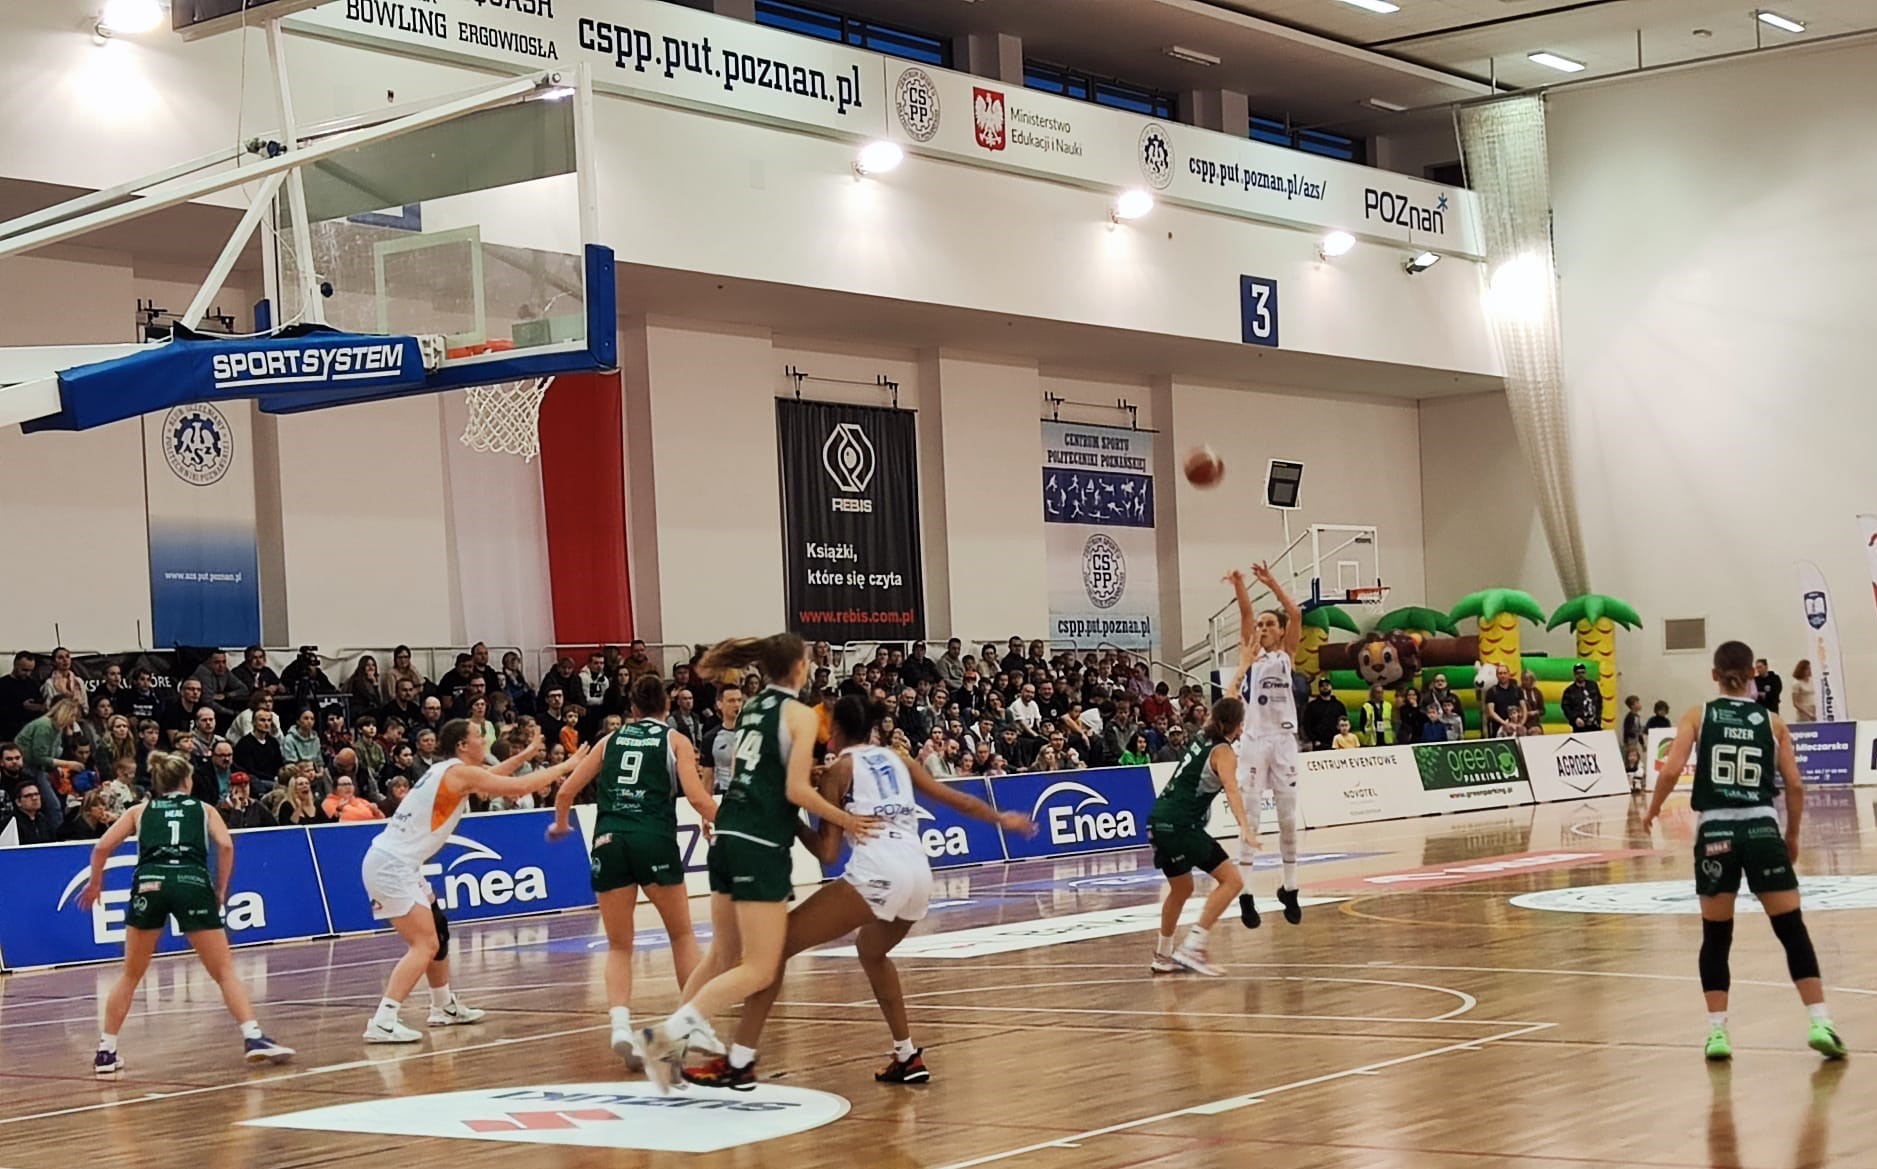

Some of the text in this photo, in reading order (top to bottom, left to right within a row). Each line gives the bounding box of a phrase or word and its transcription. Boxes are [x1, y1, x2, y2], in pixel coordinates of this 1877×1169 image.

[346, 0, 559, 60] BOWLING ERGOWIOSŁA
[579, 18, 862, 115] cspp.put.poznan.pl
[909, 87, 927, 106] CS
[909, 104, 928, 123] PP
[1010, 106, 1071, 133] Ministerstwo
[1011, 128, 1083, 156] Edukacji i Nauki
[1189, 156, 1327, 200] cspp.put.poznan.pl/azs/
[1251, 283, 1271, 338] 3
[1065, 433, 1129, 451] CENTRUM SPORTU
[1047, 450, 1098, 467] POLITECHNIKI
[831, 498, 873, 513] REBIS
[806, 542, 858, 562] Książki,
[1093, 554, 1111, 571] CS
[807, 569, 902, 589] które się czyta
[1093, 572, 1112, 588] PP
[799, 608, 915, 627] www.rebis.com.pl
[1058, 616, 1151, 638] cspp.put.poznan.pl
[1723, 727, 1754, 740] FISZER
[617, 750, 643, 784] 9
[1307, 755, 1398, 771] CENTRUM EVENTOWE
[1447, 747, 1498, 782] green
[1556, 754, 1601, 777] AGROBEX
[1711, 744, 1762, 787] 66
[1343, 788, 1378, 799] NOVOTEL
[167, 820, 180, 846] 1
[1048, 803, 1136, 846] Enea
